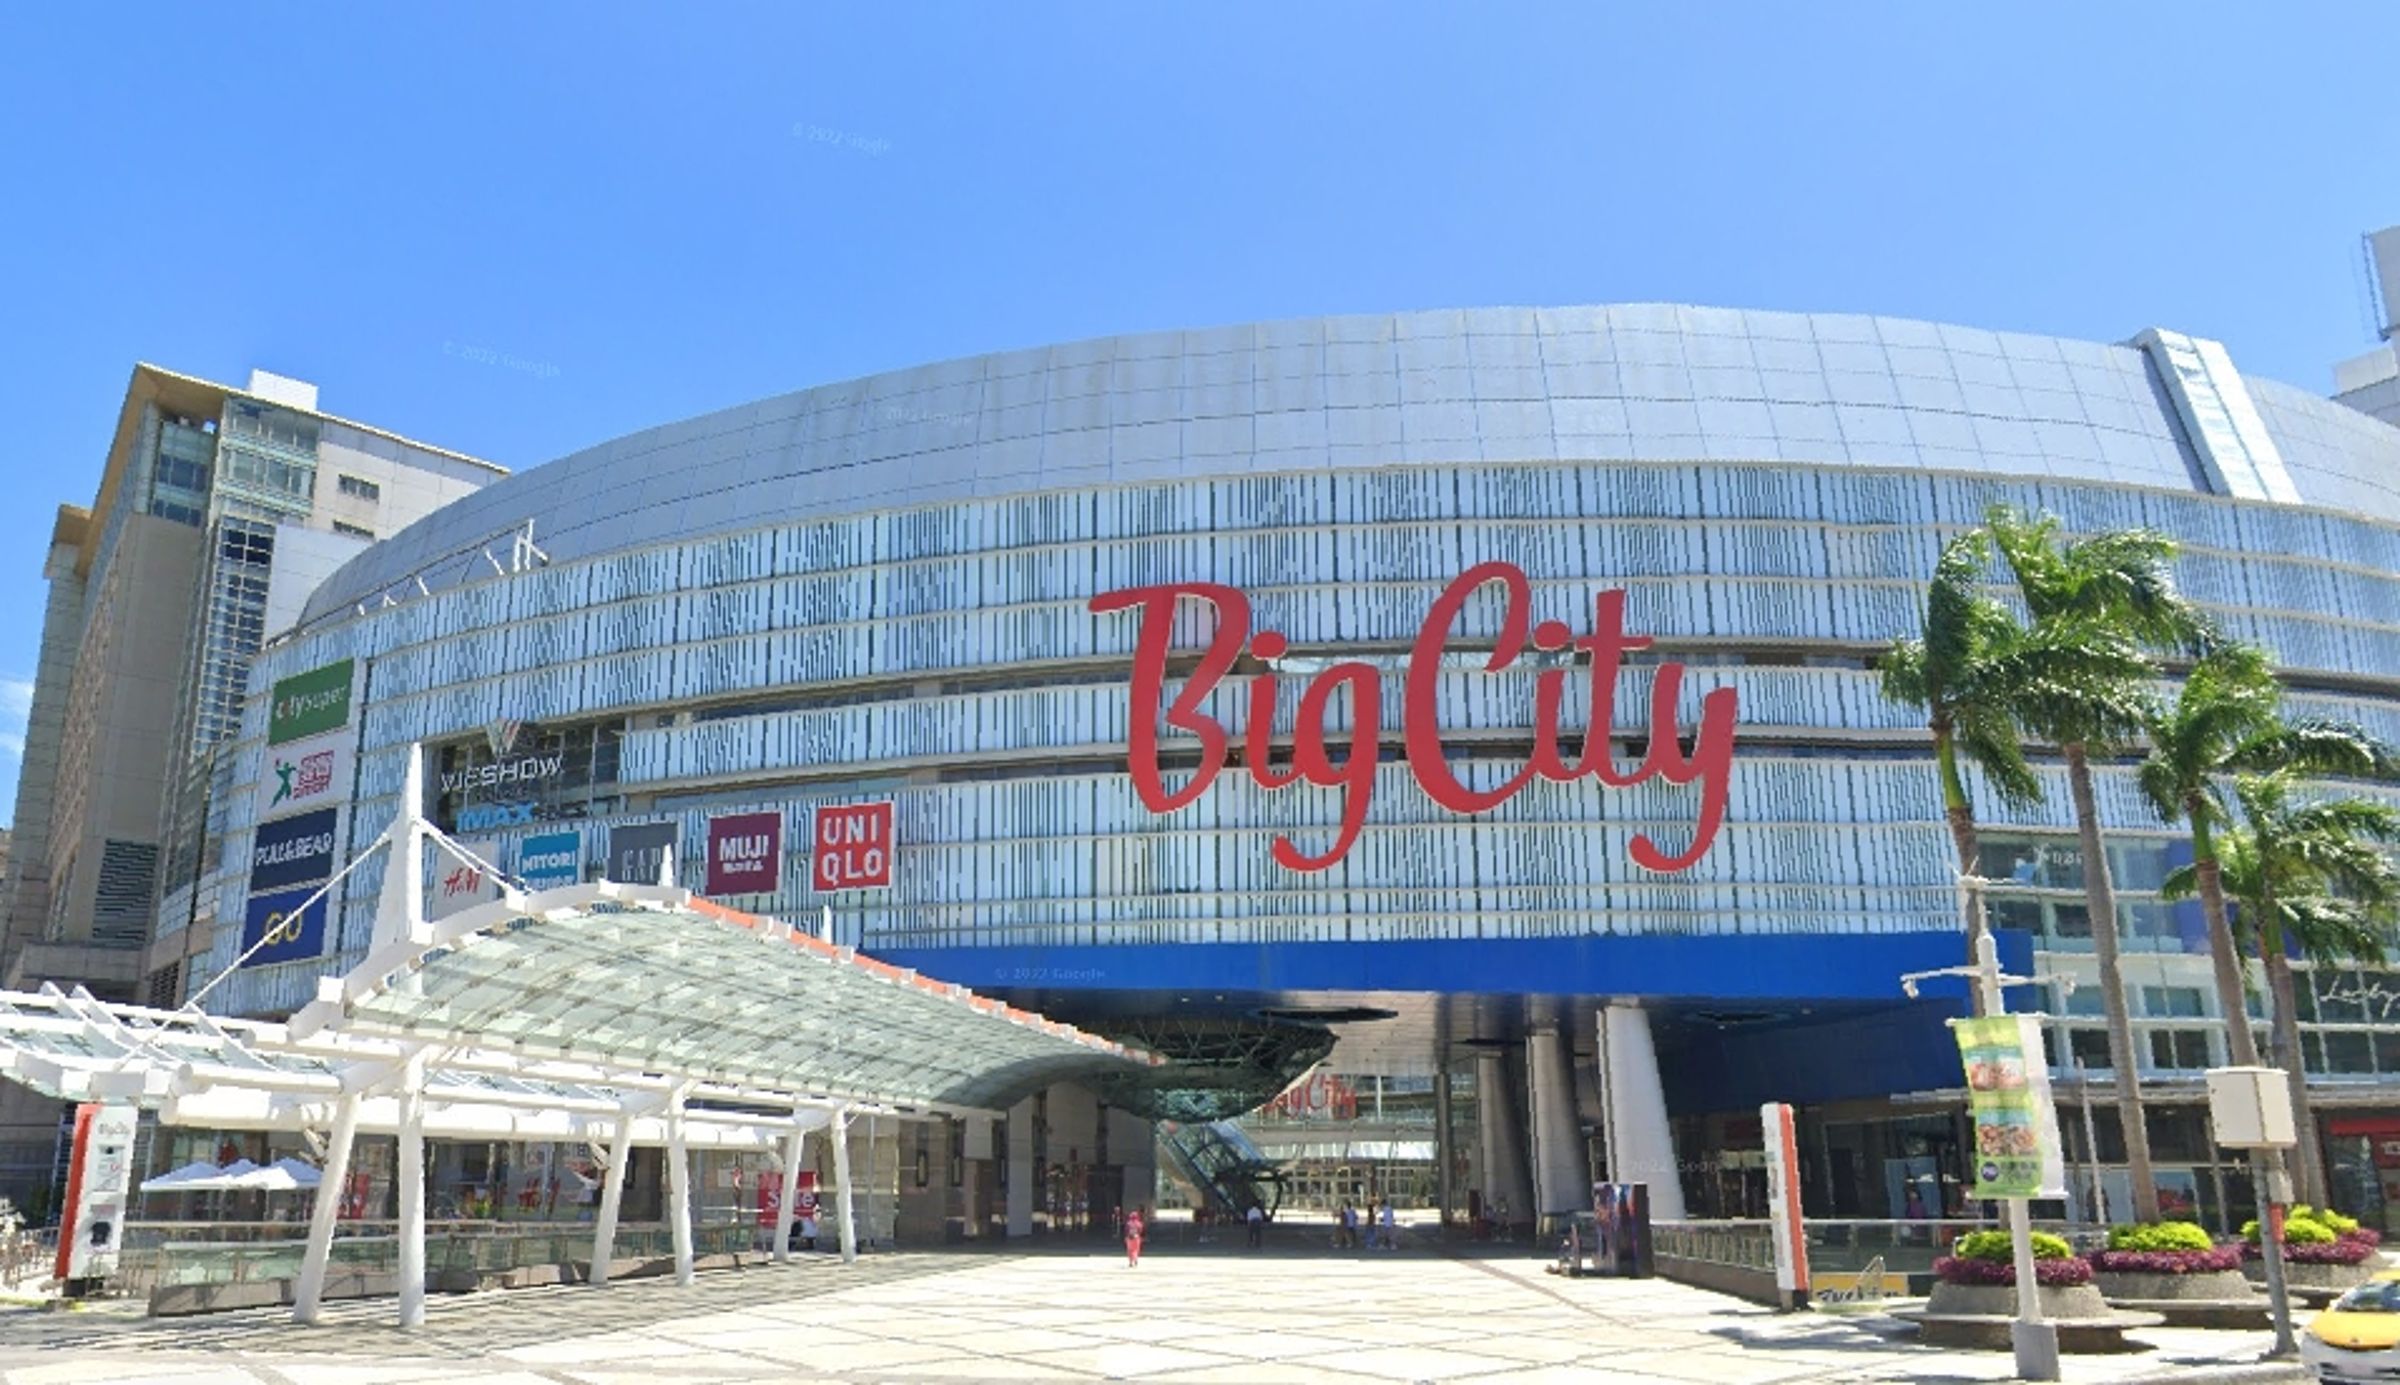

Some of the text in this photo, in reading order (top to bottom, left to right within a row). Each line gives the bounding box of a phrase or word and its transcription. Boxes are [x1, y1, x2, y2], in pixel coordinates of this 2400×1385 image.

[441, 756, 566, 793] VIESHOW
[456, 802, 535, 834] IMAX
[823, 814, 880, 846] UNI
[521, 850, 576, 874] NITORI
[719, 834, 769, 862] MUJI
[822, 848, 883, 886] QLO
